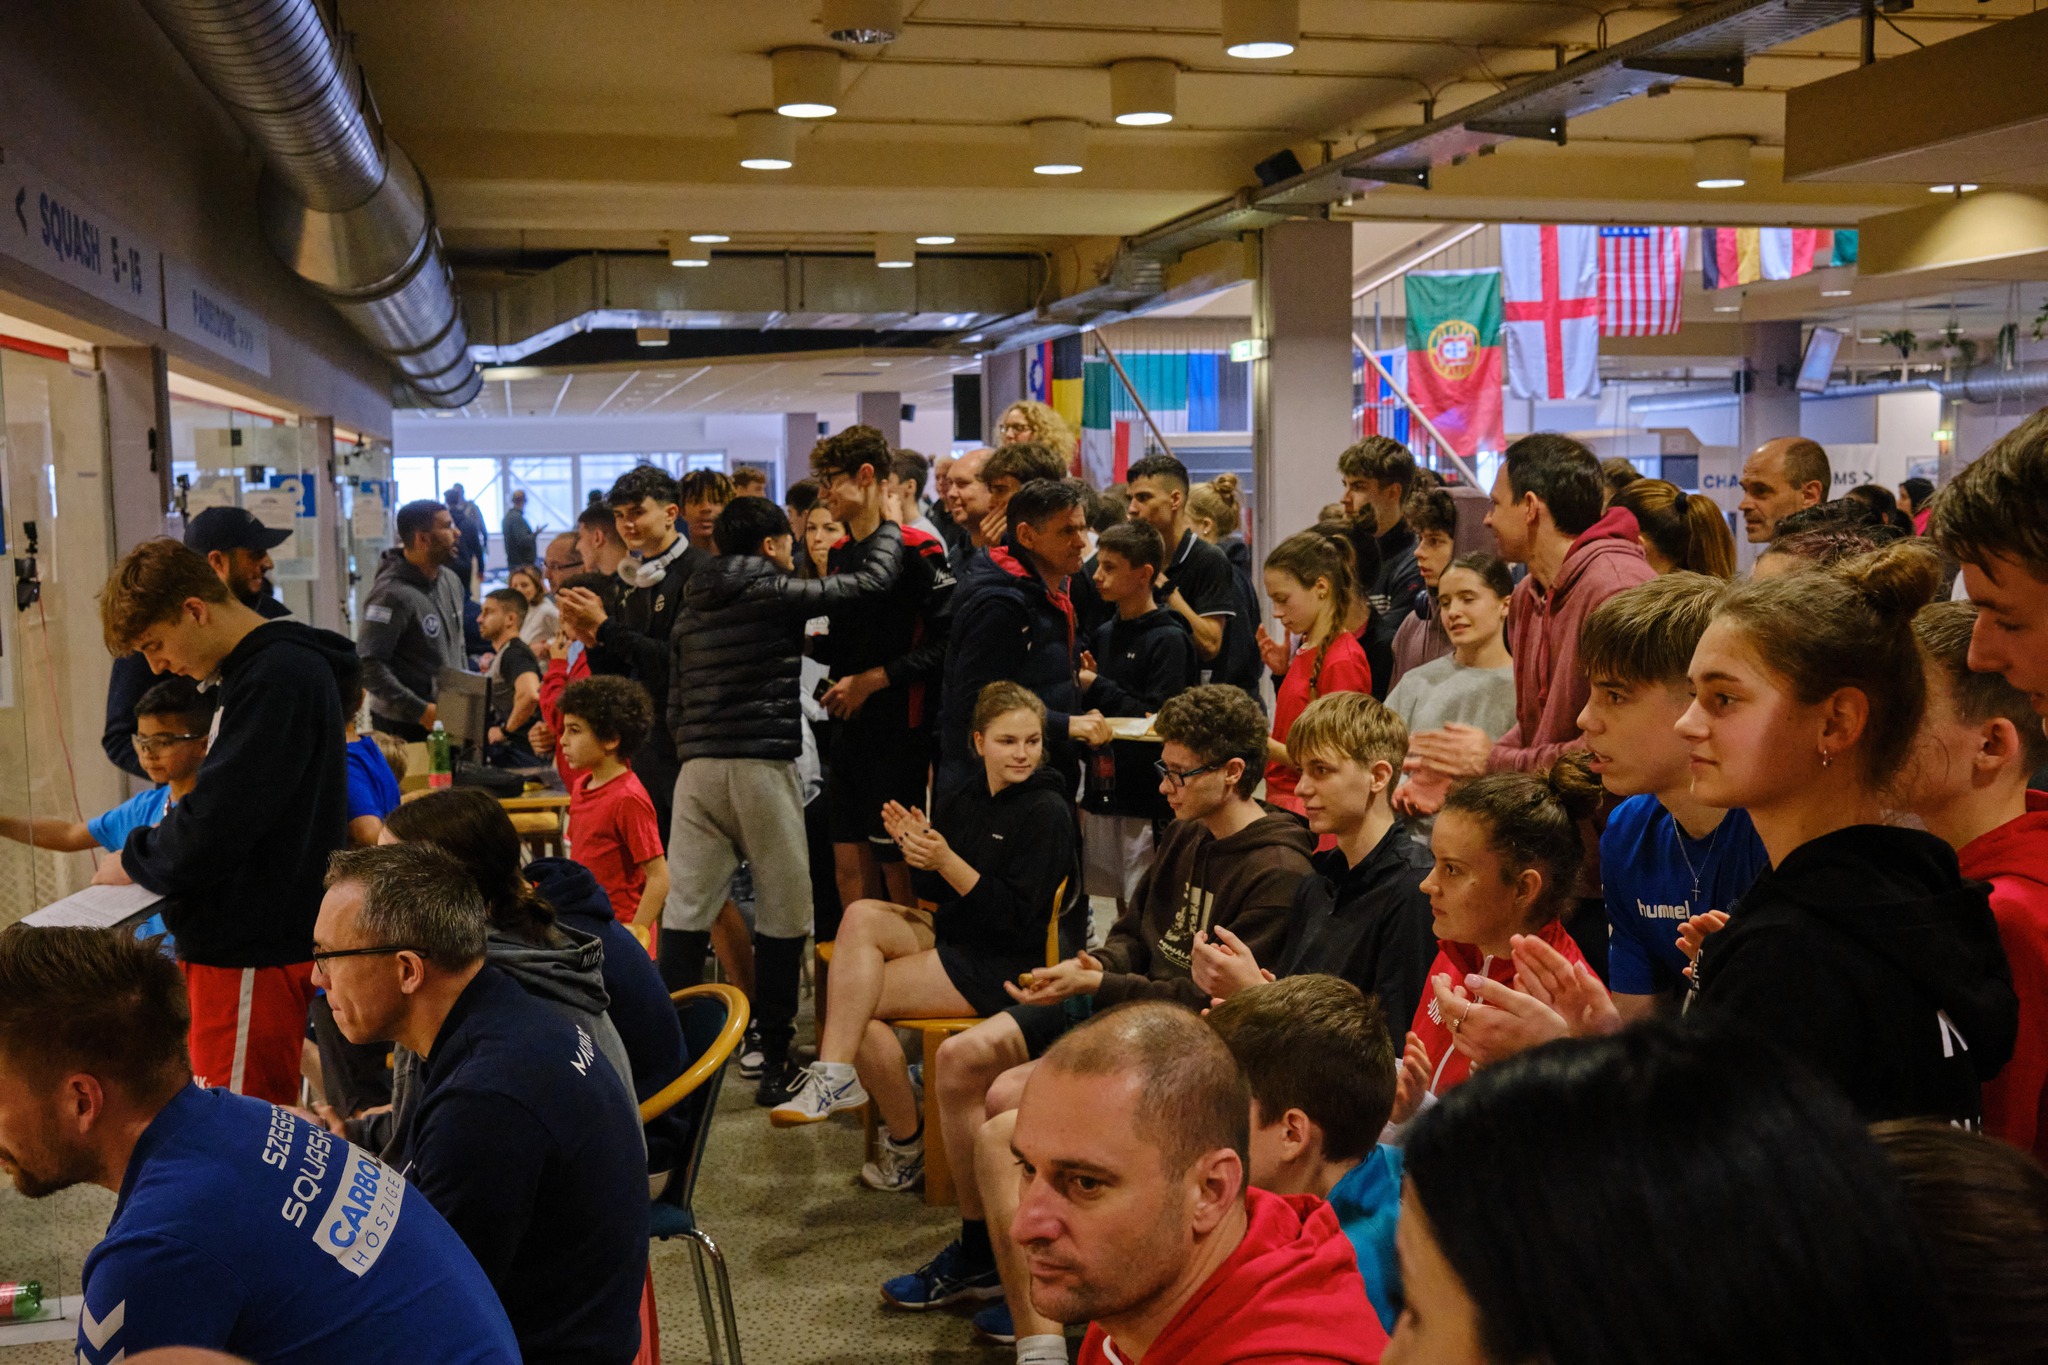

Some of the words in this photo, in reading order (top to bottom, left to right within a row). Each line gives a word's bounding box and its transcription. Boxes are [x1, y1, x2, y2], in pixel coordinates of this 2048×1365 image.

[40, 191, 101, 275] SQUASH
[1703, 474, 1740, 489] CHA
[1833, 471, 1857, 485] MS
[262, 1104, 296, 1171] SZEGE
